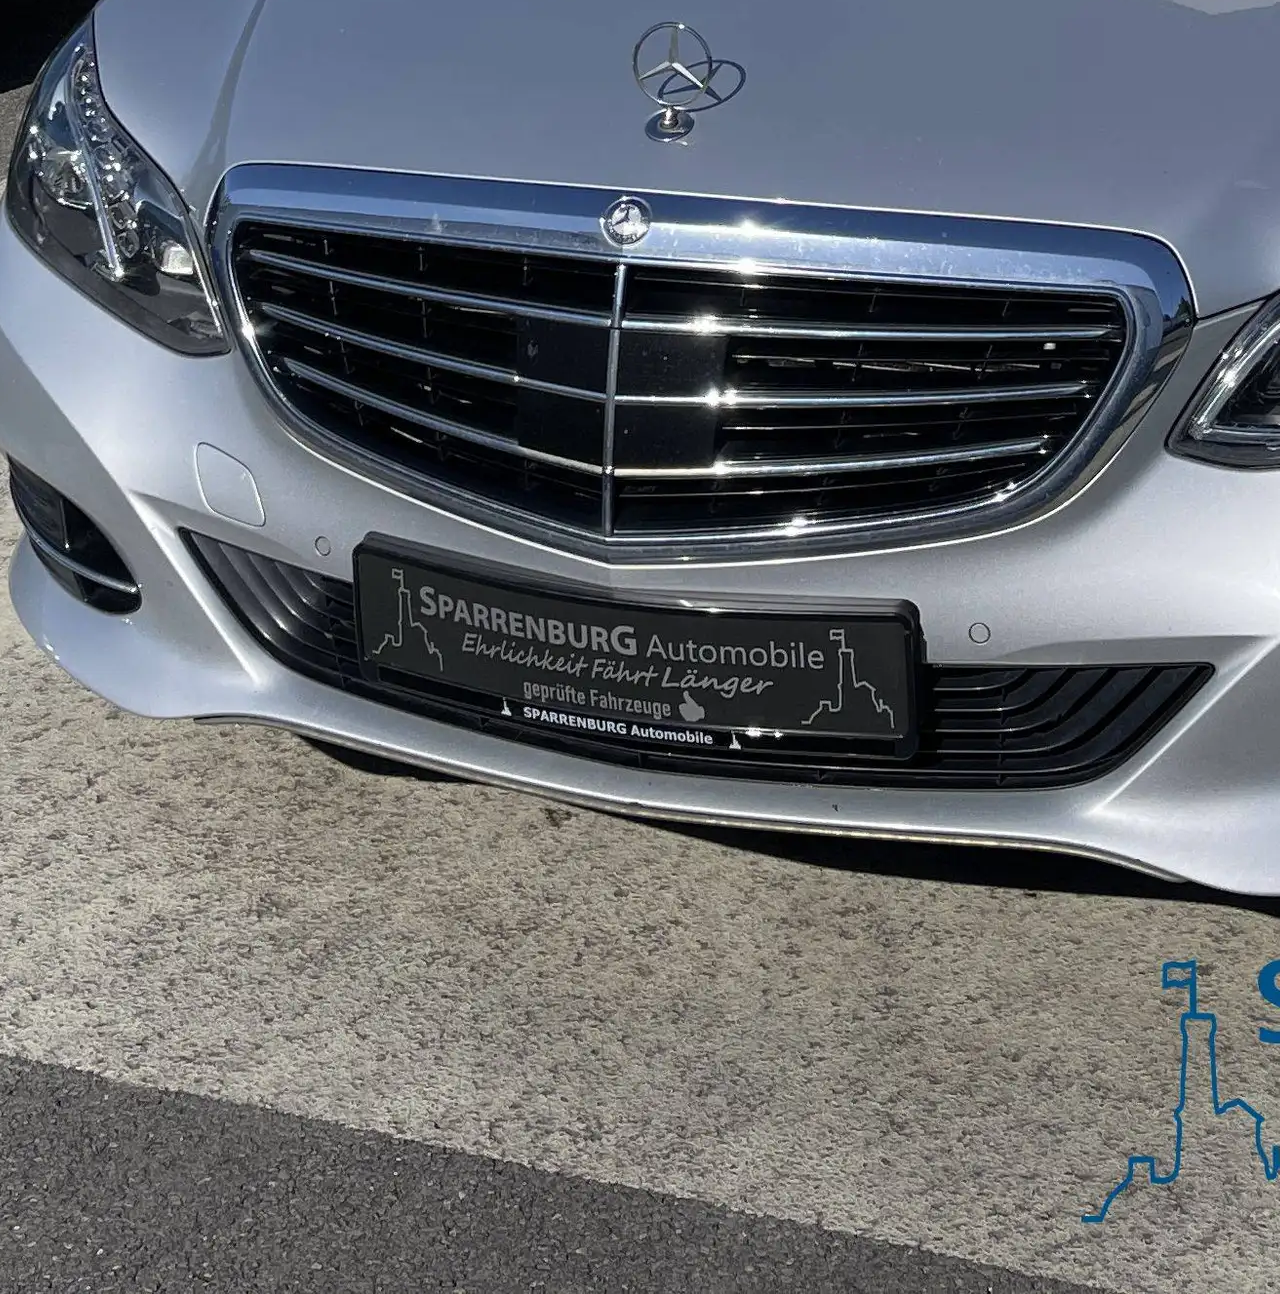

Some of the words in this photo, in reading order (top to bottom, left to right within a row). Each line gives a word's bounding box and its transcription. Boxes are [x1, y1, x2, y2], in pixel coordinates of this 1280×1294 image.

[419, 585, 638, 657] SPARRENBURG
[646, 634, 825, 670] Automobile
[461, 632, 588, 677] Ehrlichkeit
[591, 657, 658, 688] Fährt
[661, 666, 774, 699] Länger
[522, 679, 587, 707] geprüfte
[589, 688, 672, 718] Fahrzeuge
[523, 706, 627, 735] SPARRENBURG
[629, 724, 714, 745] Automobile
